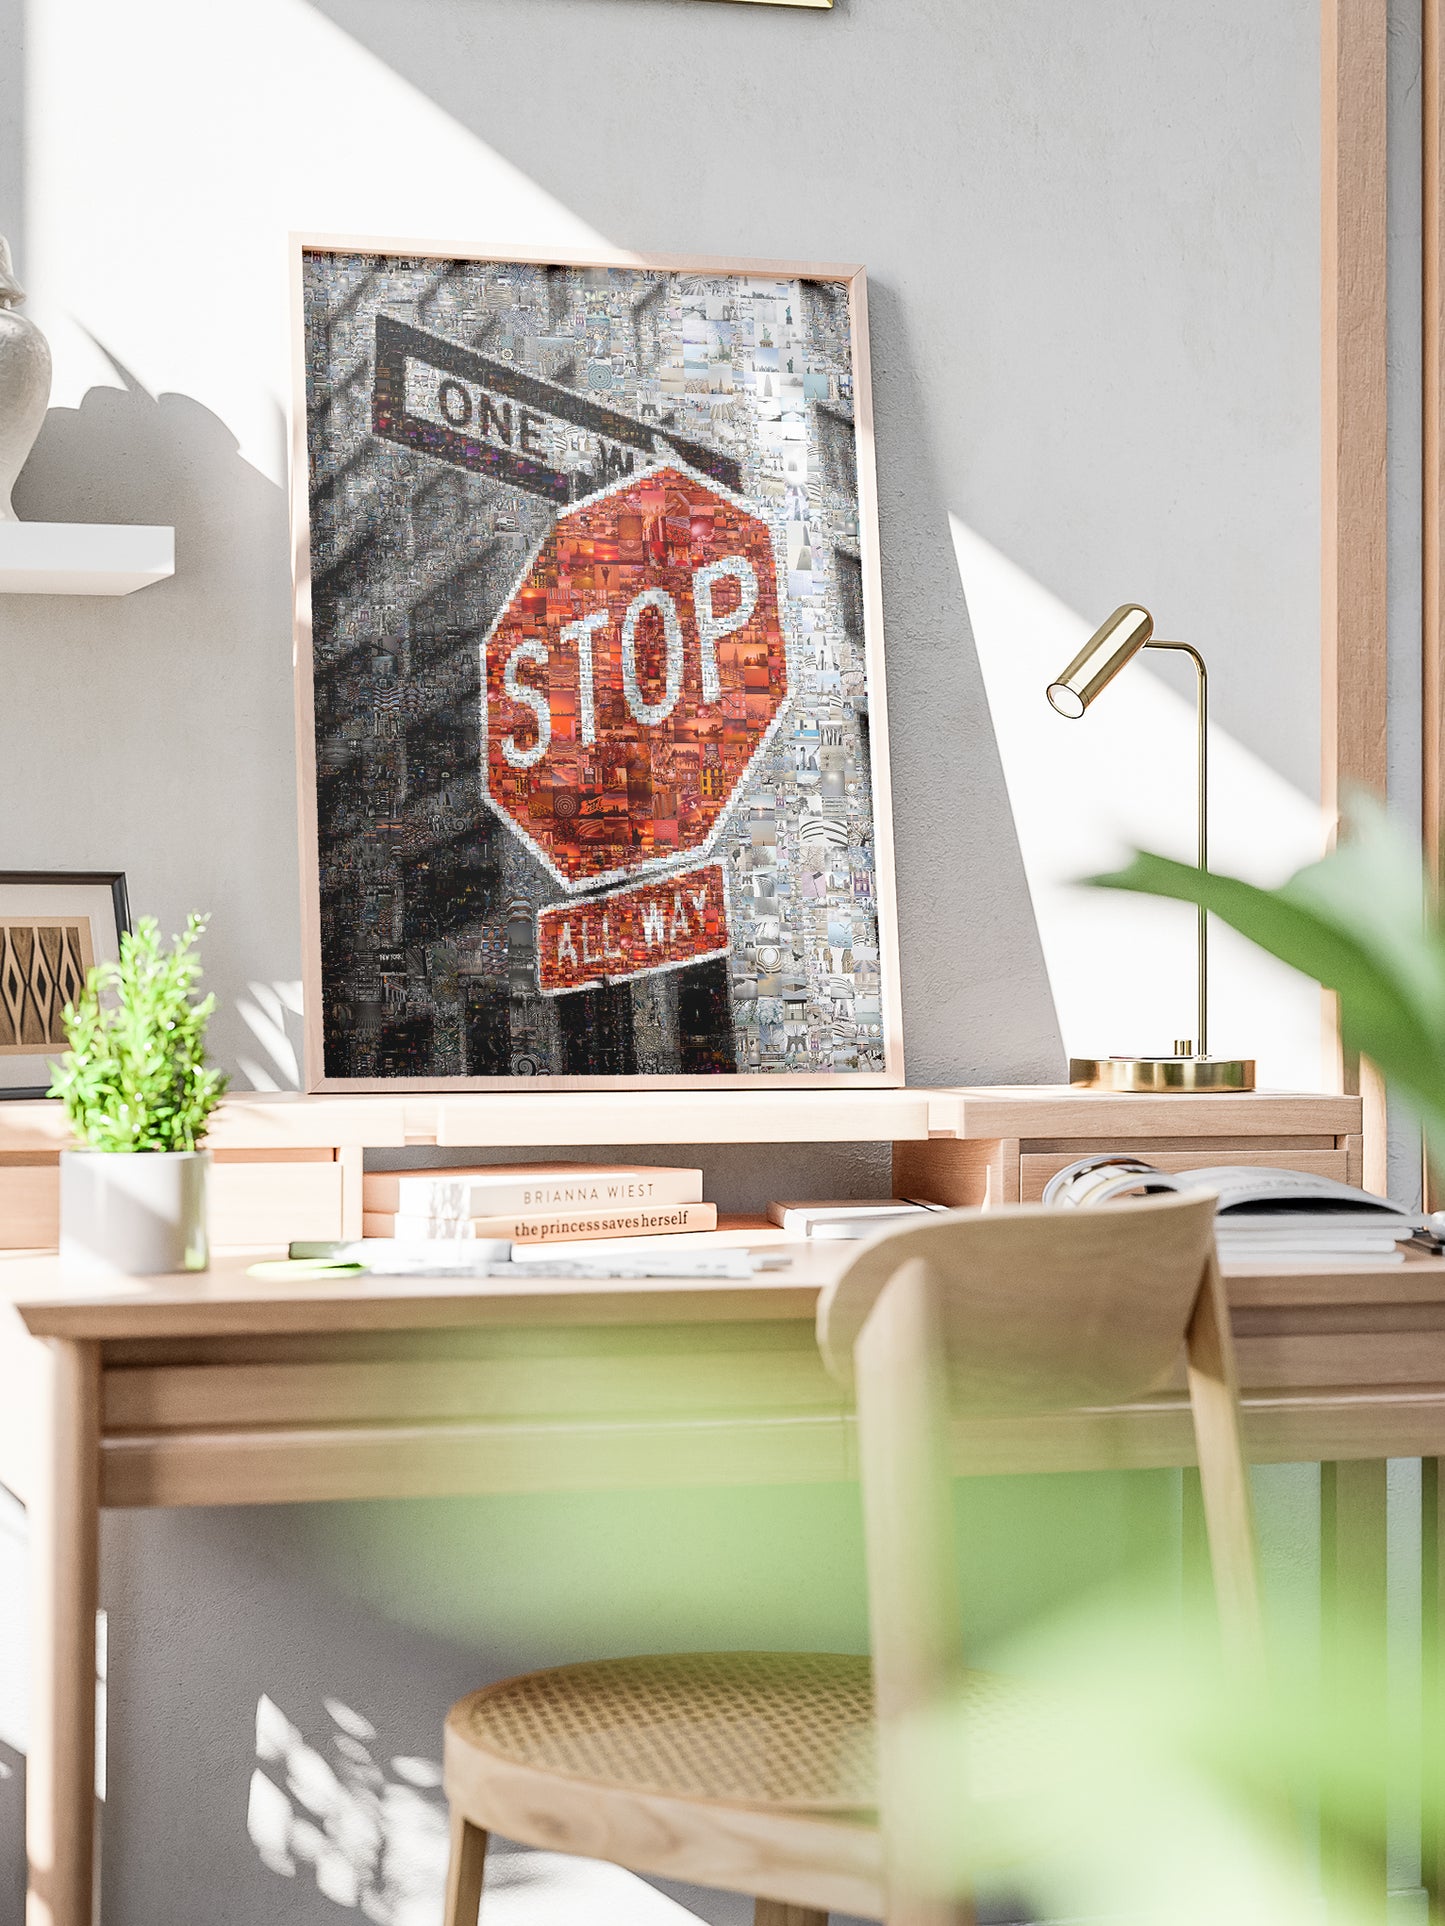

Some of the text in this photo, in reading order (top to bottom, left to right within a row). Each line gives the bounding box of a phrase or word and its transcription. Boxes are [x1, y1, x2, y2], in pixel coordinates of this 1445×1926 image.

[437, 379, 547, 461] ONE
[503, 555, 759, 769] STOP
[557, 884, 708, 969] ALL WAY
[515, 1211, 689, 1238] the princess saves herself
[523, 1183, 654, 1205] BRIANNA WIEST
